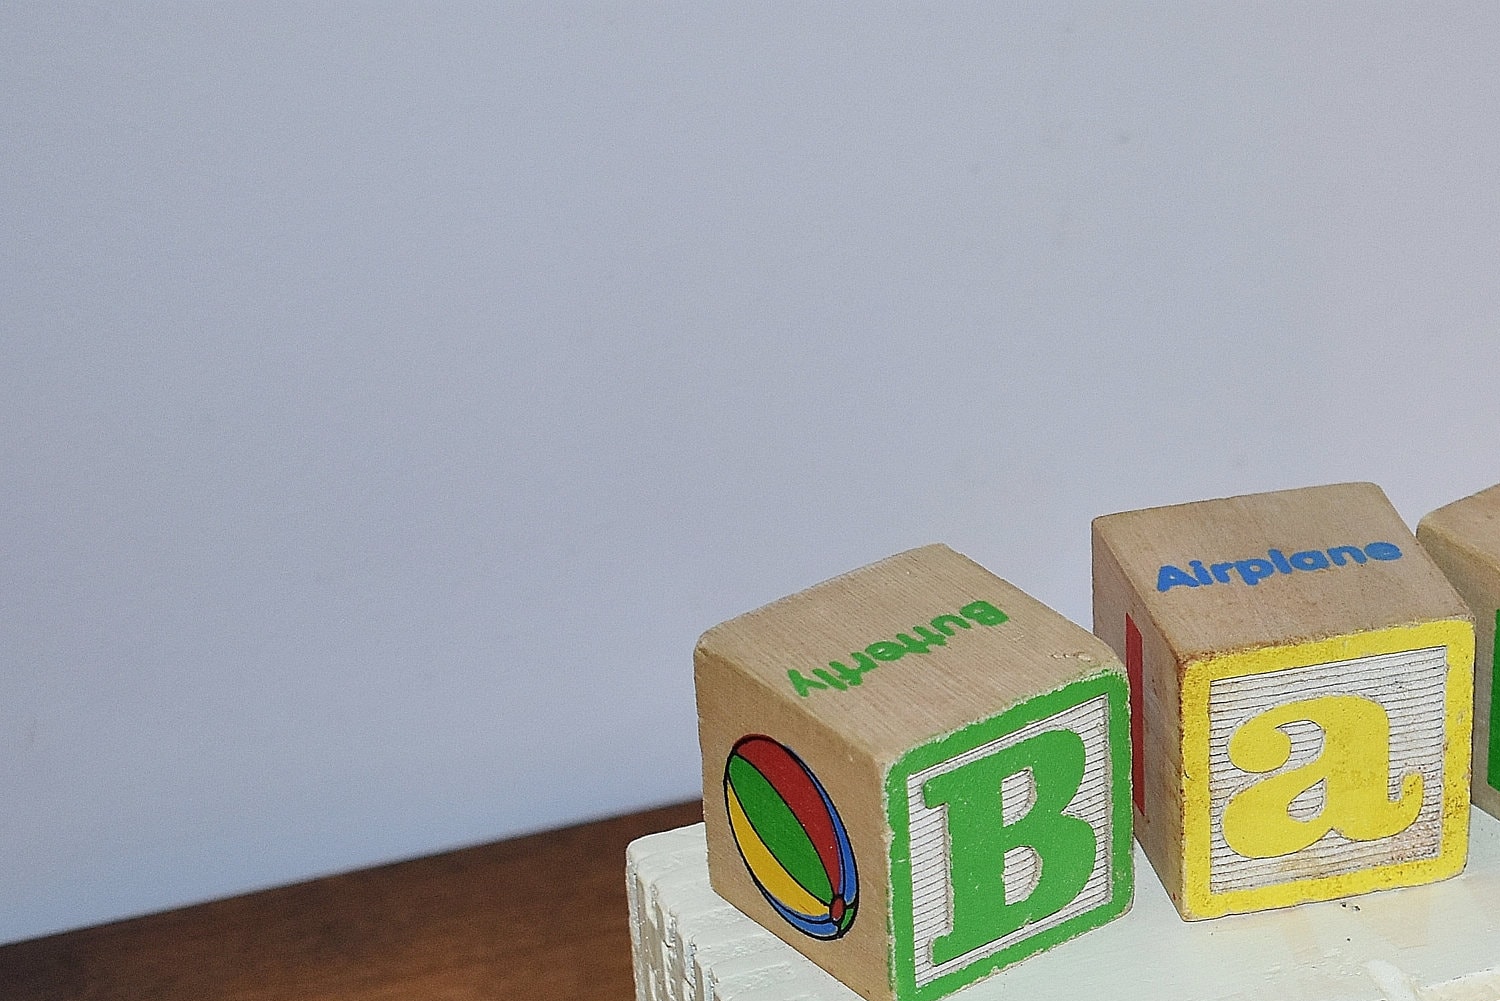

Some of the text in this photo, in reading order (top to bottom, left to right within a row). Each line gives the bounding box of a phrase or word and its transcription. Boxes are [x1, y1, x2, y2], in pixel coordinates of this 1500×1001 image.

[1156, 541, 1403, 592] Airplane
[786, 600, 1010, 697] Butterfly
[1223, 695, 1423, 859] a
[922, 729, 1098, 966] B
